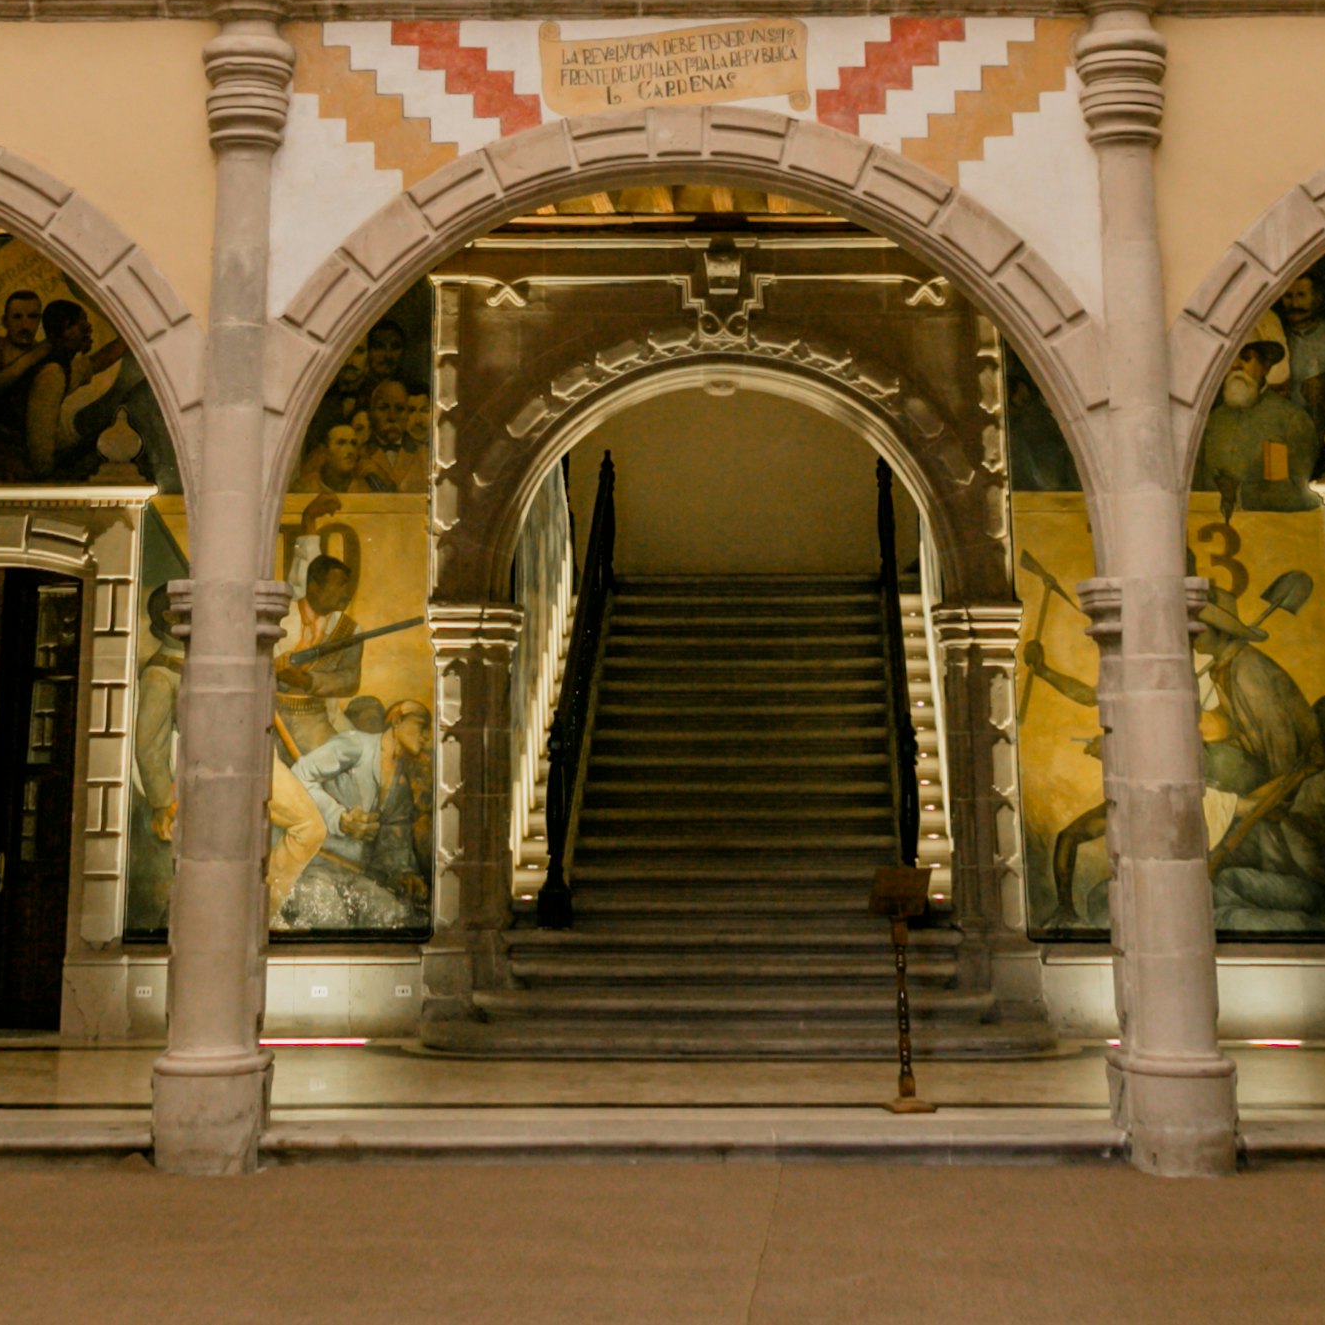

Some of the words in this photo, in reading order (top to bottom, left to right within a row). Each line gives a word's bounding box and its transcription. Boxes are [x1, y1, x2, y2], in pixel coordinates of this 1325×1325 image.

[562, 49, 579, 65] LA
[663, 36, 697, 56] DEBE
[699, 29, 746, 51] TENER
[560, 68, 609, 86] FRENTE
